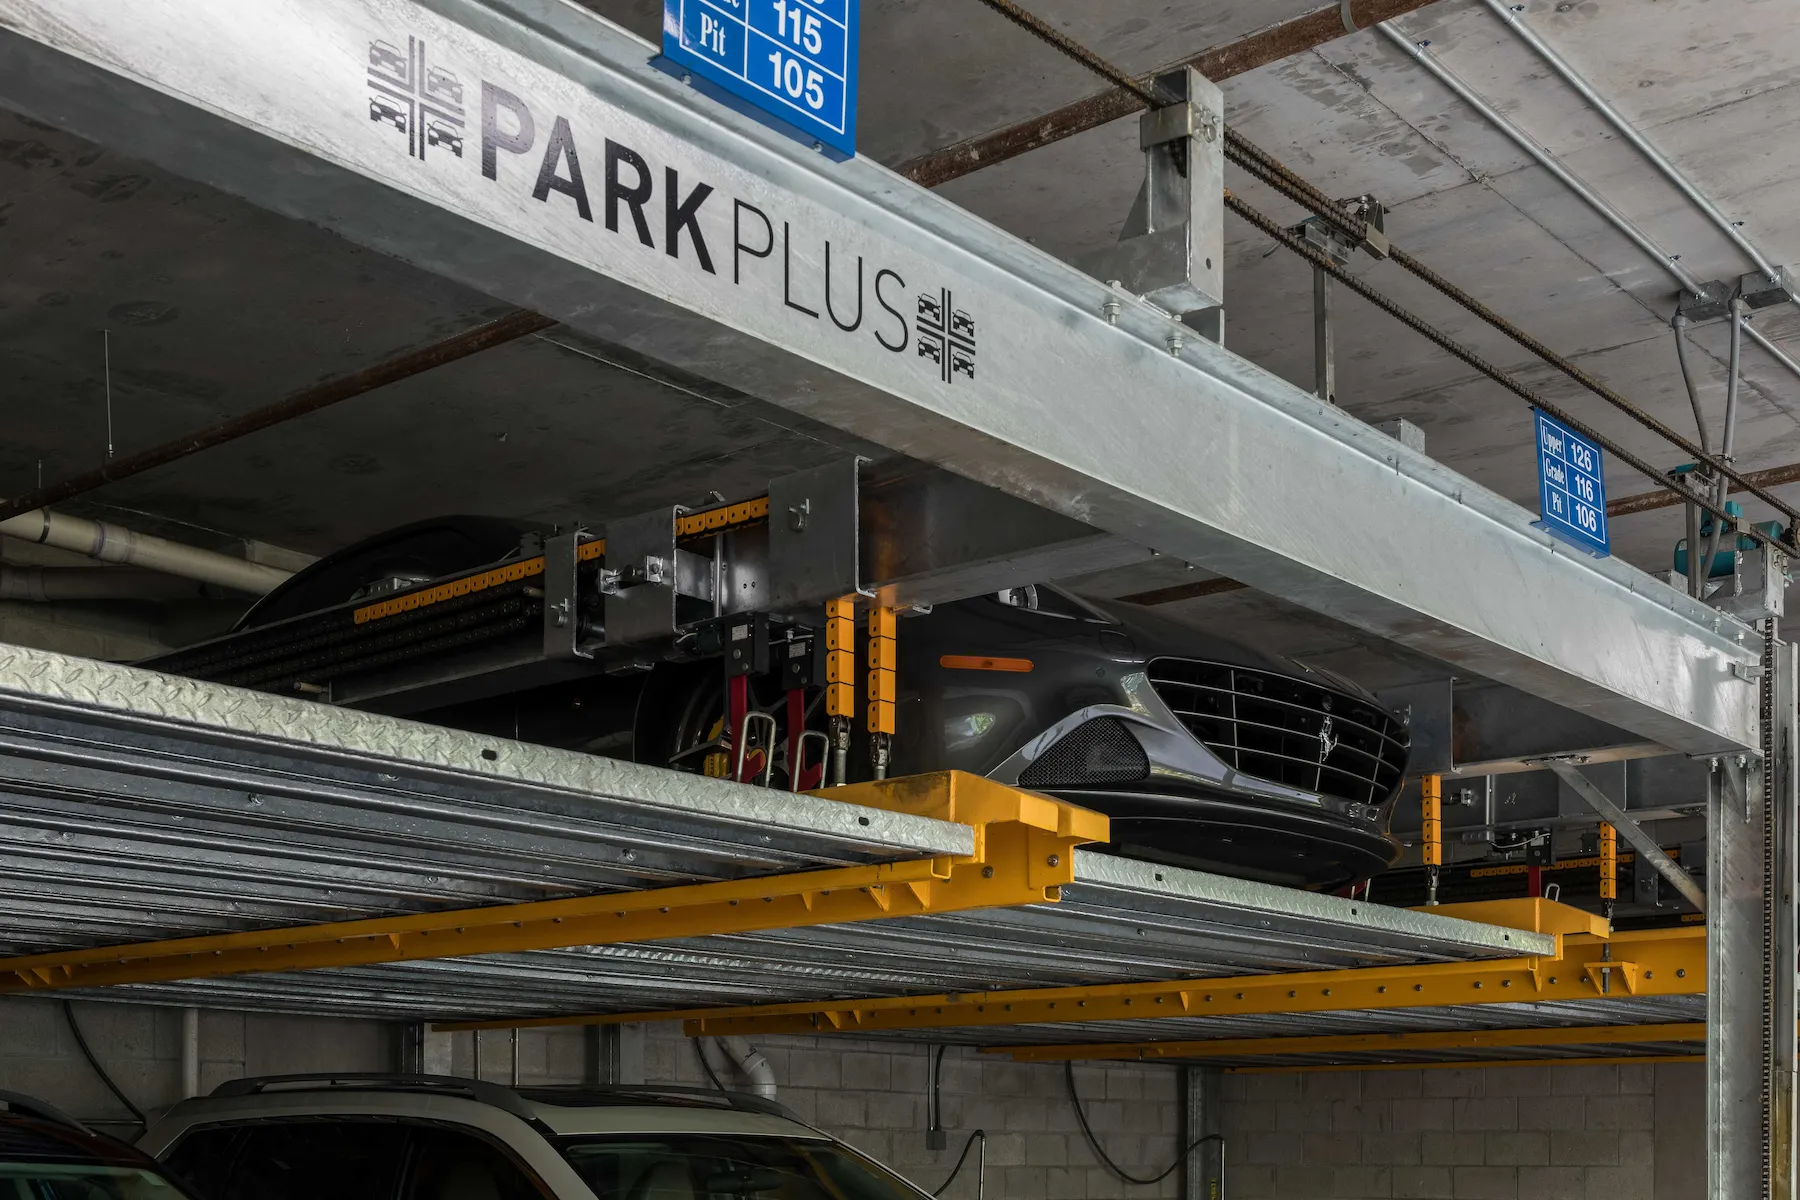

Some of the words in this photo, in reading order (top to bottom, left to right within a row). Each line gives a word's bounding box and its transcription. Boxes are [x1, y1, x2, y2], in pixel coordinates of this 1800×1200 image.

[773, 0, 822, 55] 115
[700, 12, 726, 57] Pit
[768, 51, 824, 110] 105
[1542, 425, 1563, 454] Upper
[1571, 442, 1592, 472] 126
[1545, 457, 1565, 485] Grade
[1575, 474, 1594, 503] 116
[1551, 491, 1563, 514] Pit
[1576, 503, 1597, 532] 106
